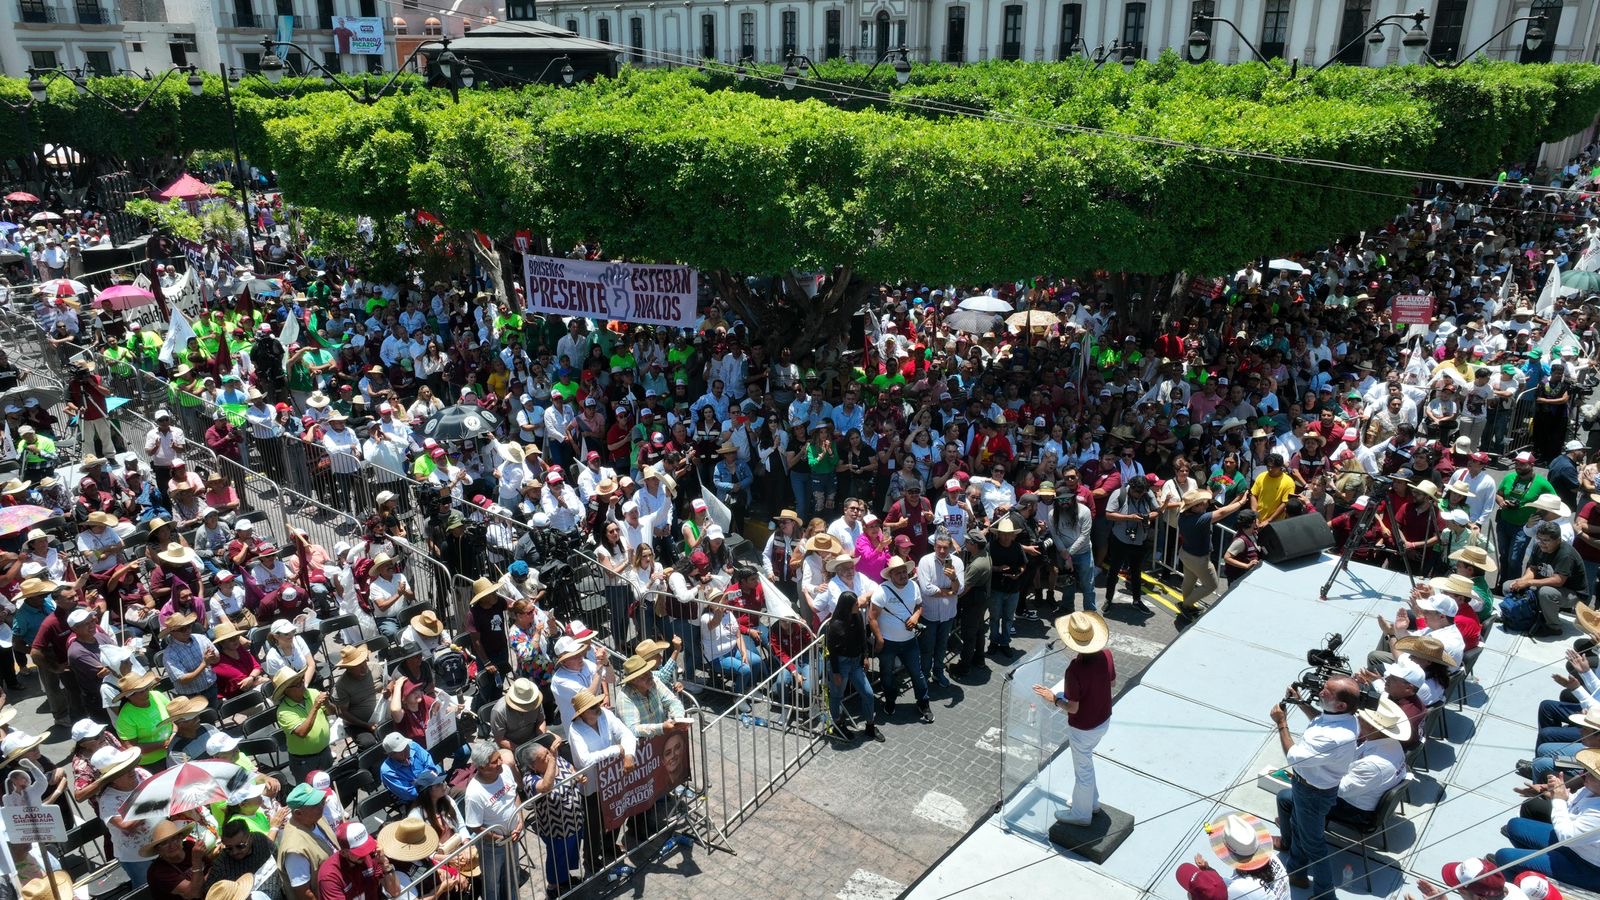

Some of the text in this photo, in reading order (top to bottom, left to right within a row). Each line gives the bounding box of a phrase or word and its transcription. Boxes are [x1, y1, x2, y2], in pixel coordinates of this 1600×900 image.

[528, 259, 565, 278] BRISEÑAS
[631, 267, 692, 294] ESTEBAN
[529, 275, 608, 314] PRESENTE
[632, 293, 682, 321] AVALOS
[944, 514, 963, 522] FER
[600, 742, 653, 789] SAHAYO
[602, 781, 623, 801] ESTA
[623, 755, 661, 787] CONTIGO!
[12, 812, 53, 820] CLAUDIA
